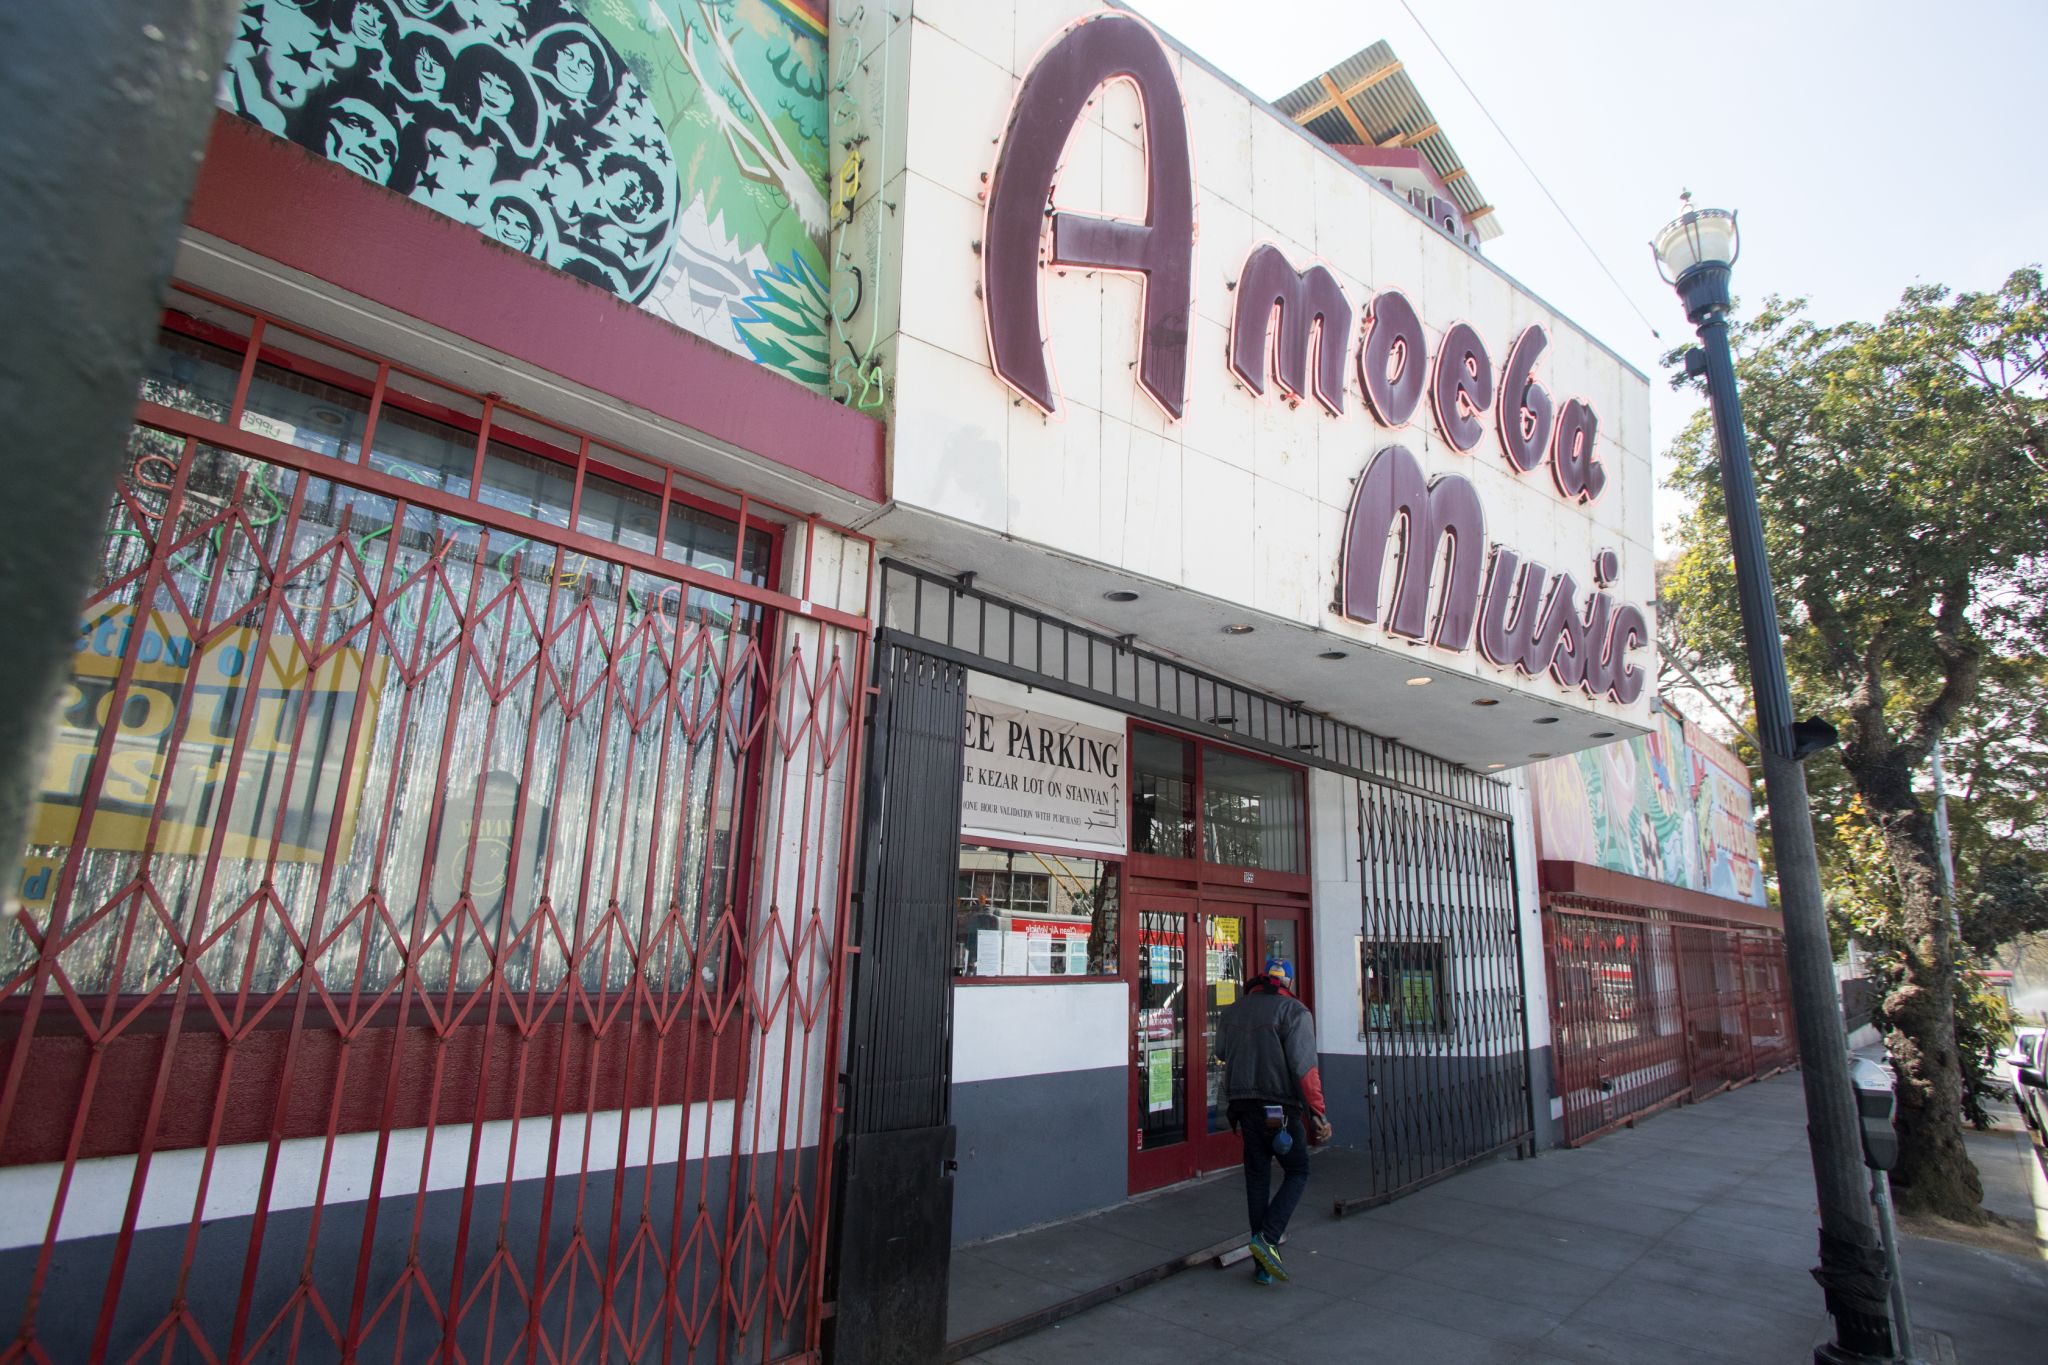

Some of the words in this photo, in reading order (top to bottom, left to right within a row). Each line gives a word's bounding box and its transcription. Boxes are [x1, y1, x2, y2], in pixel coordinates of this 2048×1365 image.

[981, 8, 1608, 506] Amoeba
[1336, 444, 1649, 707] Music
[1006, 720, 1120, 778] PARKING
[978, 768, 1019, 791] KEZAR
[1023, 776, 1044, 795] LOT
[1048, 781, 1062, 798] ON
[1065, 784, 1110, 807] STANYAN
[980, 802, 999, 814] HOUR
[999, 805, 1034, 819] VALIDATION
[1034, 810, 1051, 822] WITH
